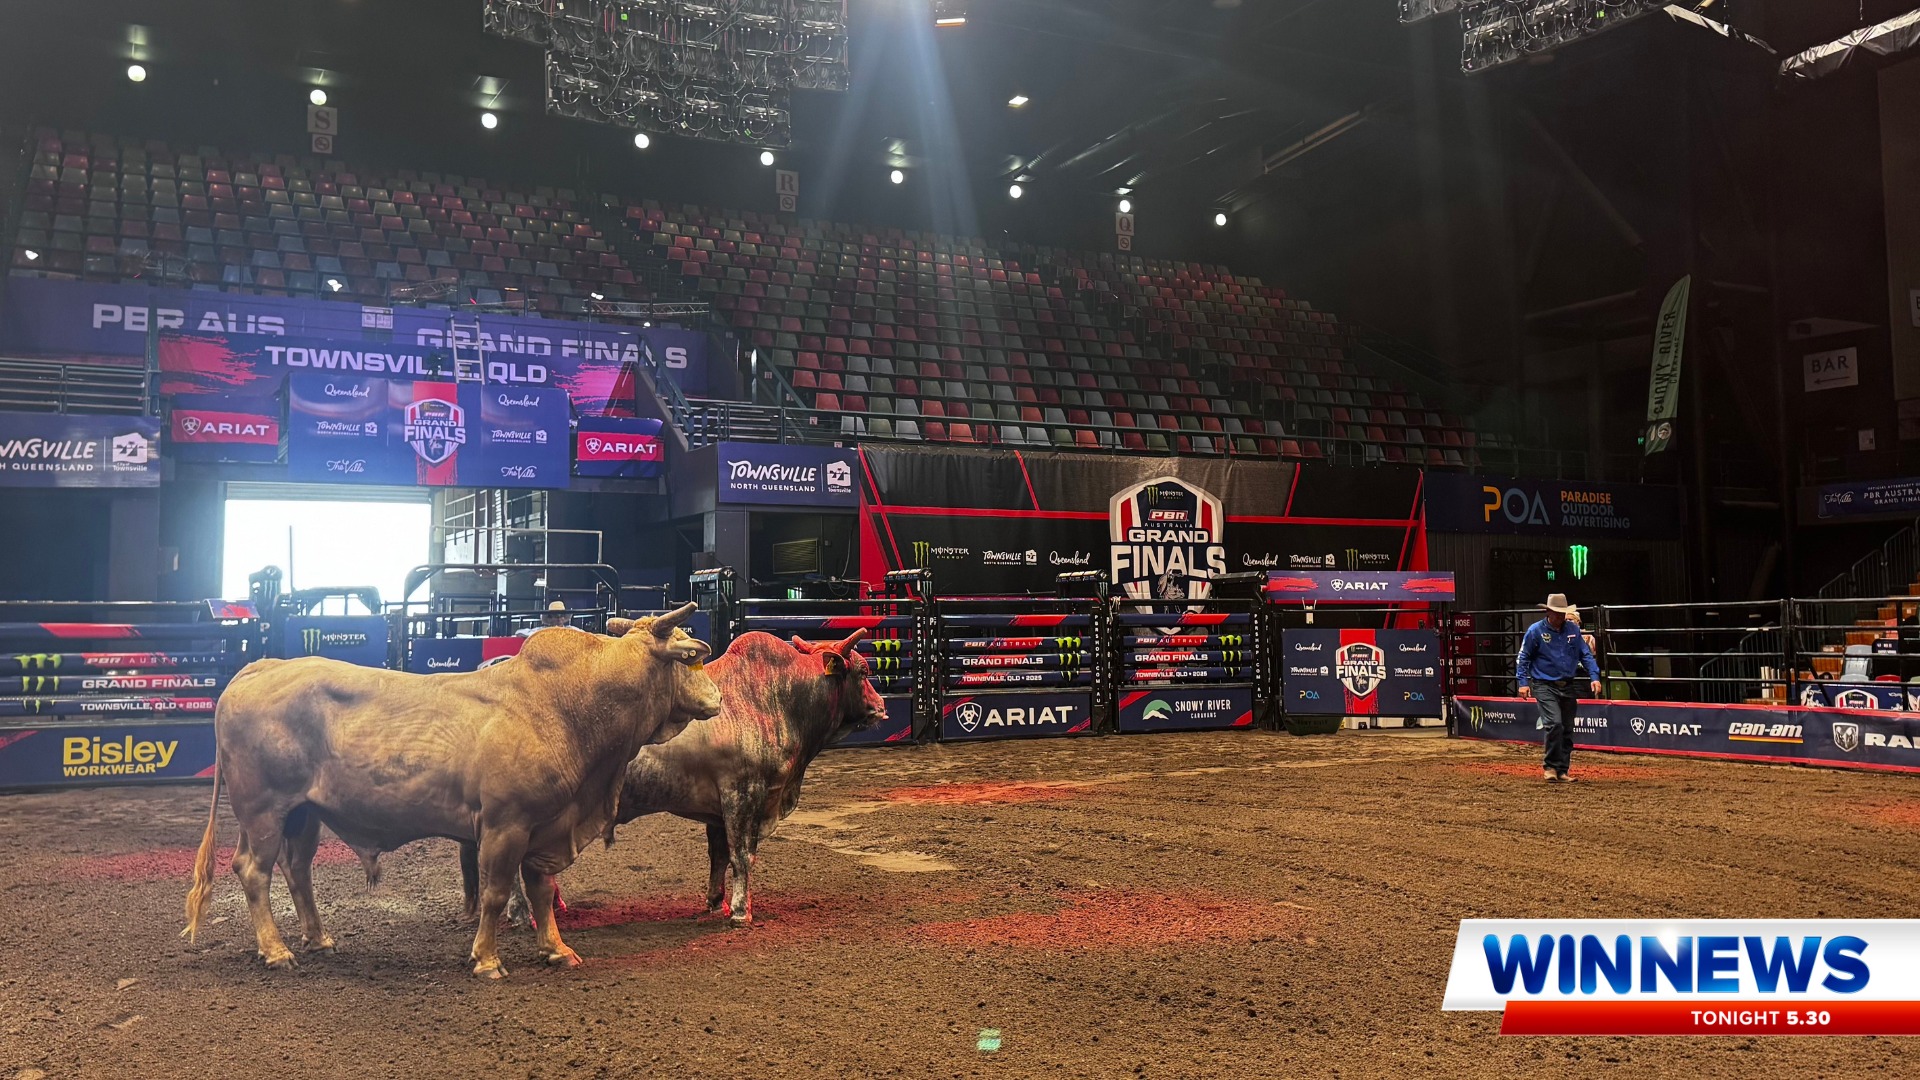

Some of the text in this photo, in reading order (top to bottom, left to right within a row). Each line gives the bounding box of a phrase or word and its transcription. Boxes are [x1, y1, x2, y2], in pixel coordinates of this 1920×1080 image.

[315, 109, 330, 130] S
[780, 173, 795, 192] R
[1119, 216, 1132, 232] Q
[1659, 311, 1676, 354] RIVER
[1811, 355, 1849, 373] BAR
[488, 362, 547, 383] QLD
[324, 383, 370, 398] Queensland
[498, 393, 540, 407] Queensland
[201, 421, 270, 436] ARIAT
[316, 421, 361, 432] TOWNSVILLE
[404, 426, 466, 445] FINALS
[491, 429, 532, 439] TOWNSVILLE
[602, 443, 657, 454] ARIAT
[12, 463, 93, 471] QUEENSLAND
[113, 464, 148, 472] Townsville
[727, 460, 817, 482] TOWNSVILLE
[762, 484, 816, 492] QUEENSLAND
[1560, 490, 1611, 504] PARADISE
[1864, 491, 1880, 499] PBR
[1874, 497, 1899, 505] GRAND
[1483, 486, 1550, 525] POA
[1561, 502, 1614, 516] OUTDOOR
[1151, 511, 1185, 519] PBR
[1561, 515, 1631, 529] ADVERTISING
[1128, 529, 1209, 543] GRAND
[930, 546, 969, 555] MONSTER
[982, 550, 1022, 561] TOWNSVILLE
[1359, 553, 1390, 561] MONSTER
[1049, 550, 1091, 565] Queensland
[1242, 552, 1279, 567] Queensland
[1110, 545, 1227, 585] FINALS
[1343, 582, 1388, 591] ARIAT
[1455, 619, 1471, 627] HOSE
[322, 633, 367, 641] MONSTER
[129, 656, 216, 664] AUSTRALIA
[426, 657, 460, 668] Queensland
[962, 657, 1044, 666] GRAND FINALS
[1135, 653, 1208, 662] GRAND FINALS
[1336, 665, 1387, 680] FINALS
[82, 678, 216, 689] GRAND FINALS
[1299, 690, 1320, 699] POA
[1404, 691, 1425, 701] POA
[155, 702, 176, 711] QLD
[1175, 699, 1231, 712] SNOWY RIVER
[983, 705, 1073, 727] ARIAT
[1484, 711, 1517, 720] MONSTER
[1586, 717, 1608, 728] RIVER
[1647, 722, 1701, 736] ARIAT
[1728, 722, 1803, 738] can-am
[1864, 732, 1920, 749] RA
[63, 735, 179, 768] Bisley
[63, 763, 156, 777] WORKWEAR
